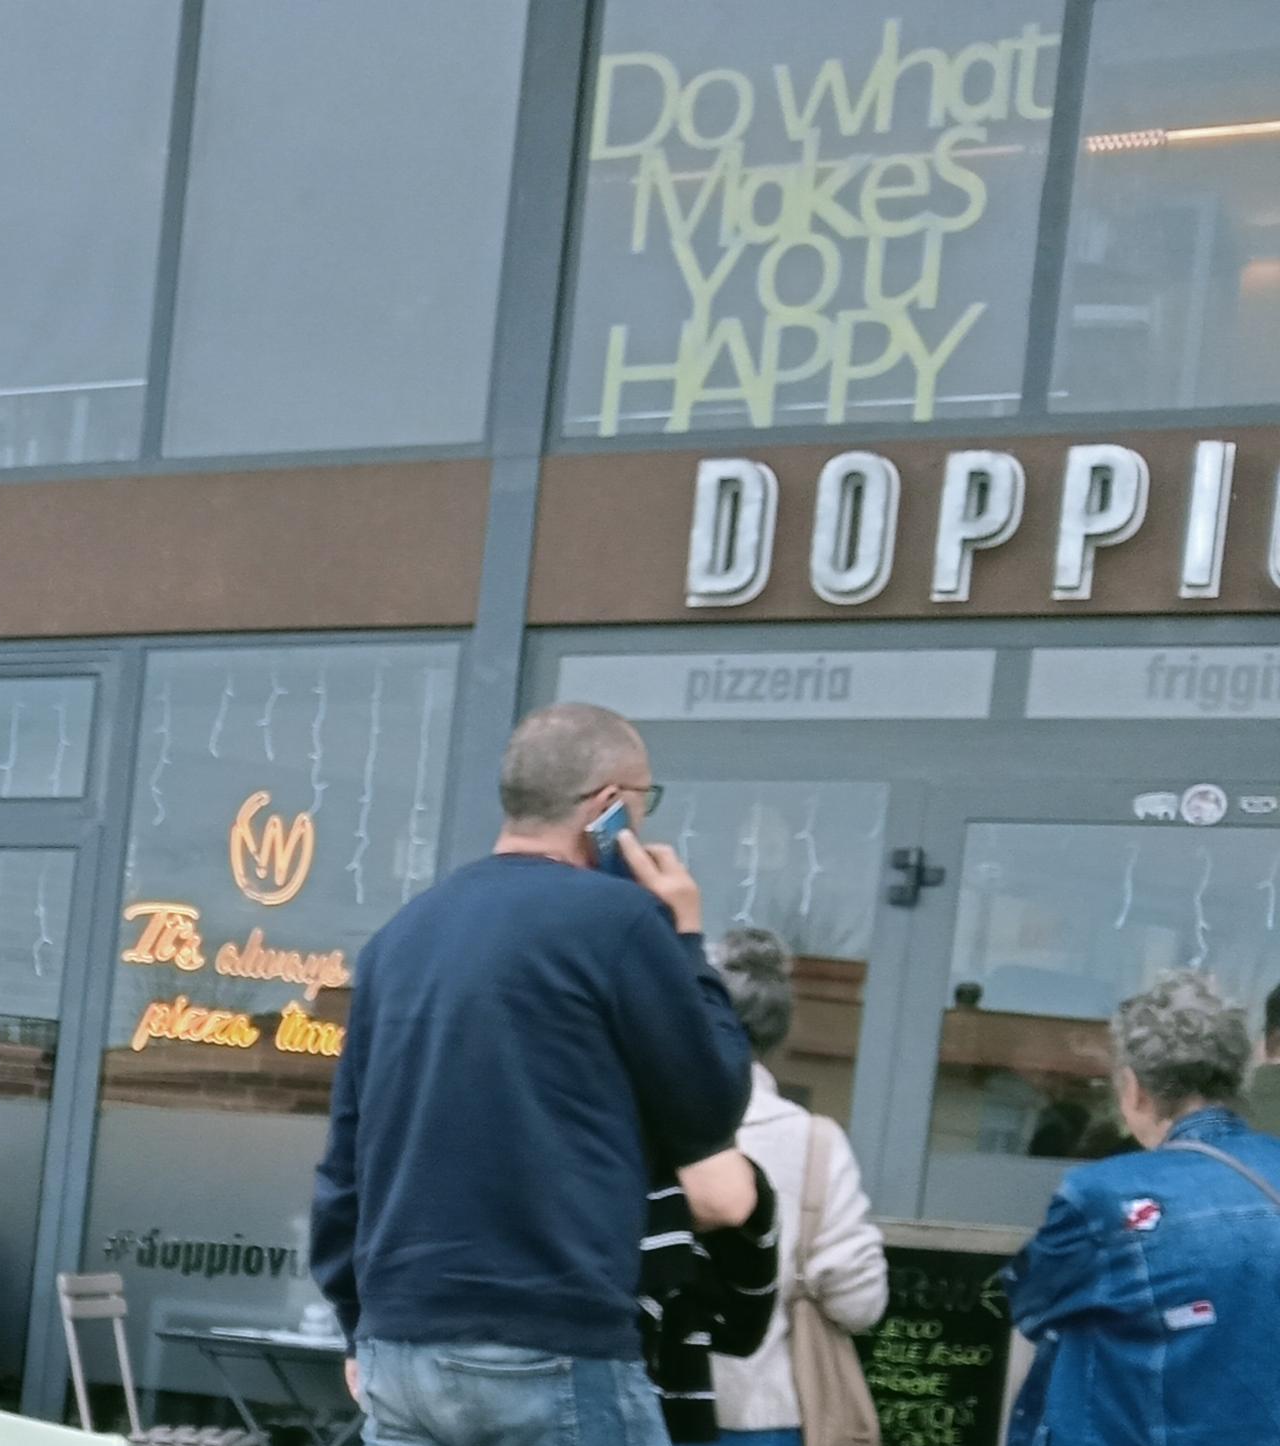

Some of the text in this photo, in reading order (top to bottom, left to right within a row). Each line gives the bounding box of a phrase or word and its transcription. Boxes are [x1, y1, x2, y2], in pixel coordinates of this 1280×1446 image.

[589, 17, 1063, 162] Do what
[597, 302, 988, 438] HAPPY
[686, 440, 1280, 607] DOPPI
[685, 657, 853, 712] pizzeria
[1145, 652, 1280, 712] friggi
